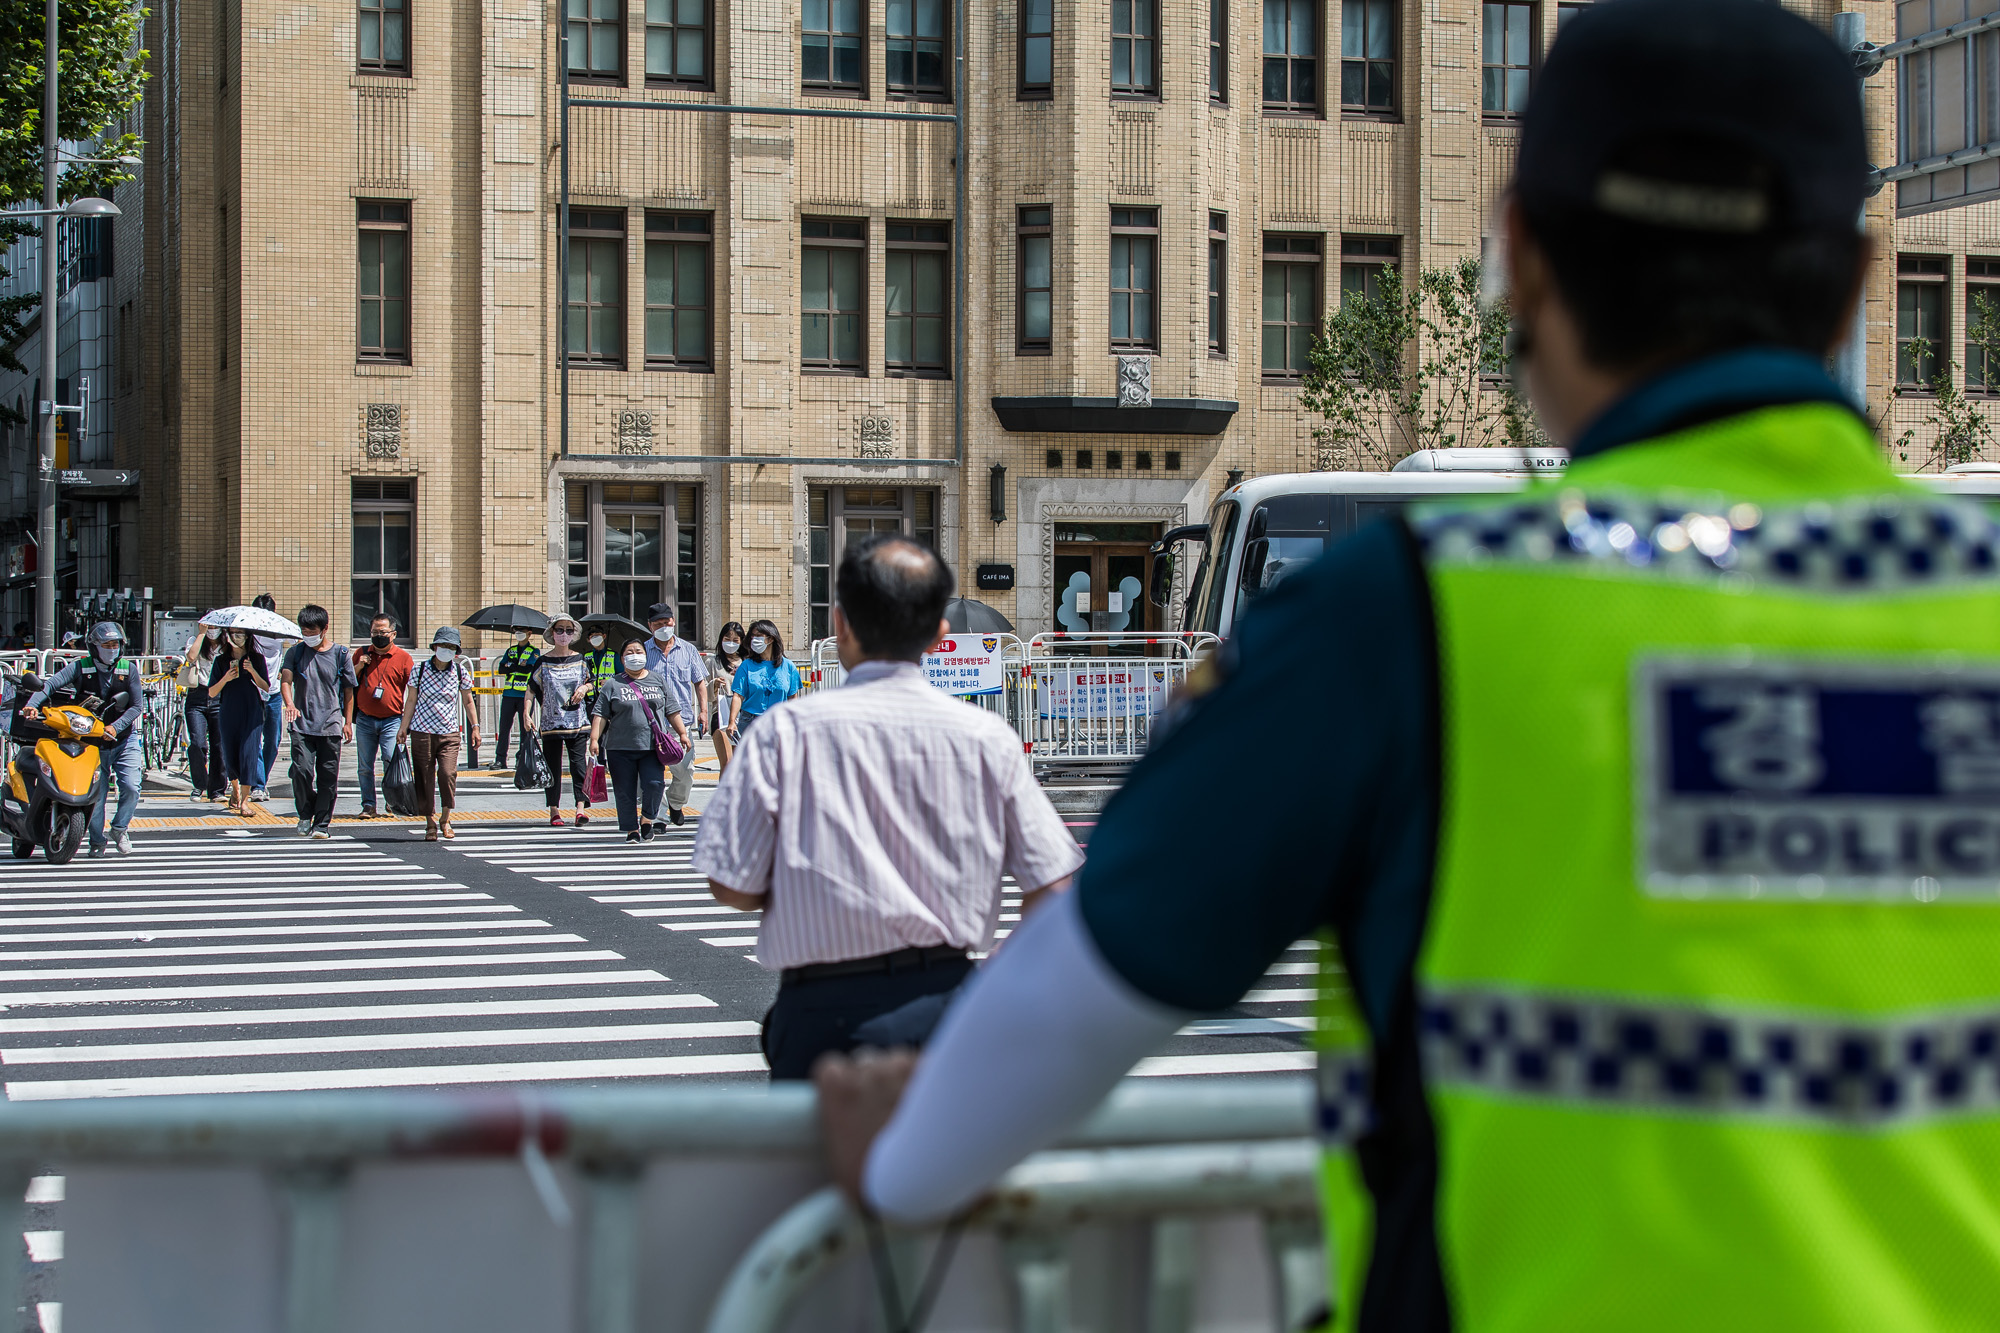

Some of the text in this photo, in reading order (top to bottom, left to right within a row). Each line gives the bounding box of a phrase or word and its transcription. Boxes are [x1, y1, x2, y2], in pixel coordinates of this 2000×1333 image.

[1536, 459, 1555, 467] KB
[927, 657, 940, 666] 위해
[943, 656, 990, 666] 감염병예방법과
[959, 668, 980, 677] 집회를
[952, 680, 982, 689] 바랍니다.
[621, 692, 662, 702] Maame
[1700, 813, 2000, 876] POLIC
